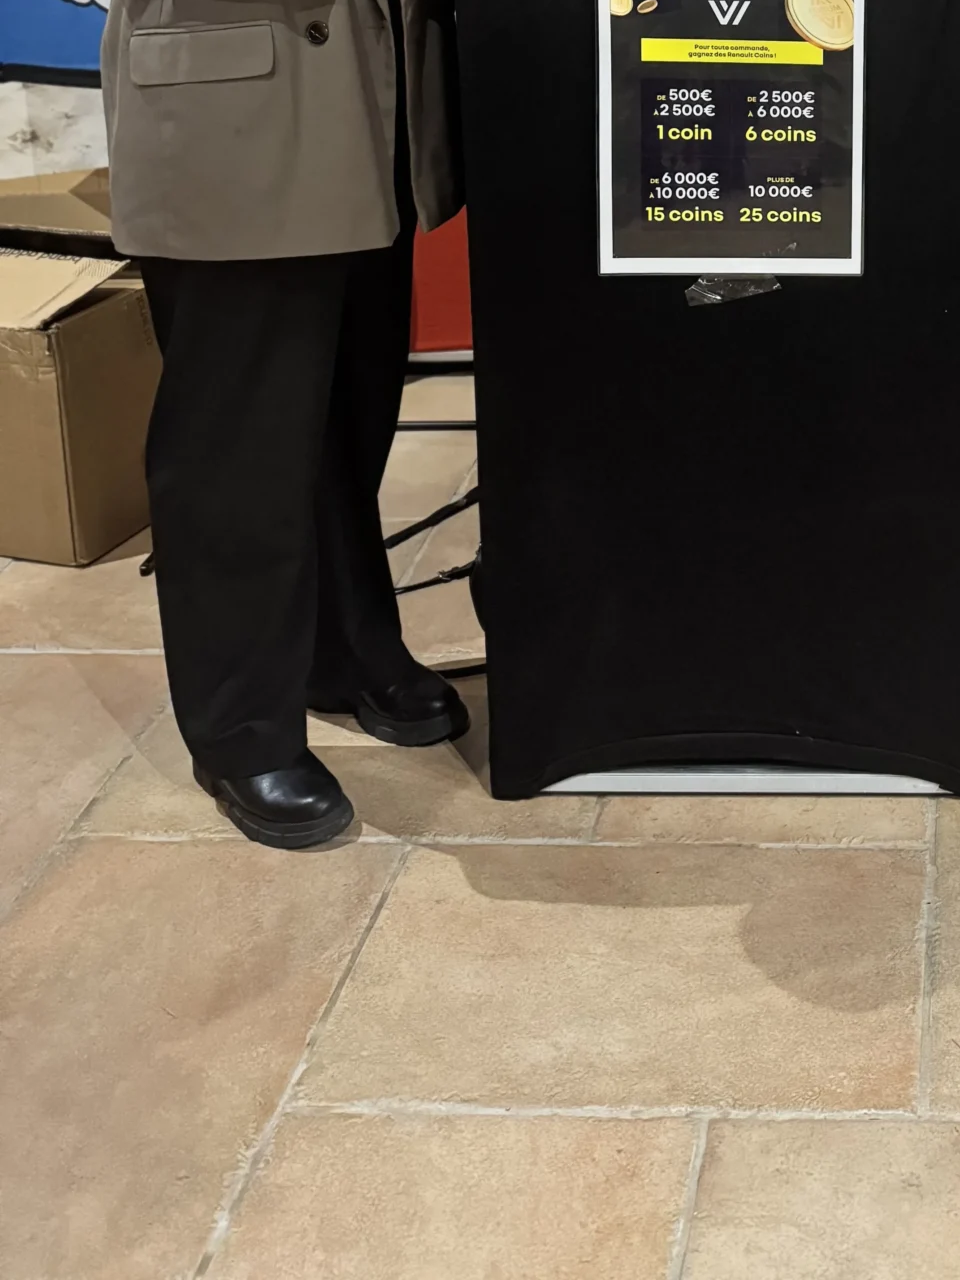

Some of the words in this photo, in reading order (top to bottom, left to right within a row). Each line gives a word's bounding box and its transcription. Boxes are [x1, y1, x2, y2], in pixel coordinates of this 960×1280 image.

[669, 89, 712, 101] 500€
[656, 125, 664, 140] 1
[668, 124, 712, 140] coin
[745, 126, 757, 141] 6
[761, 126, 817, 142] coins
[645, 207, 665, 222] 15
[669, 206, 724, 222] coins
[739, 208, 763, 222] 25
[767, 207, 822, 223] coins
